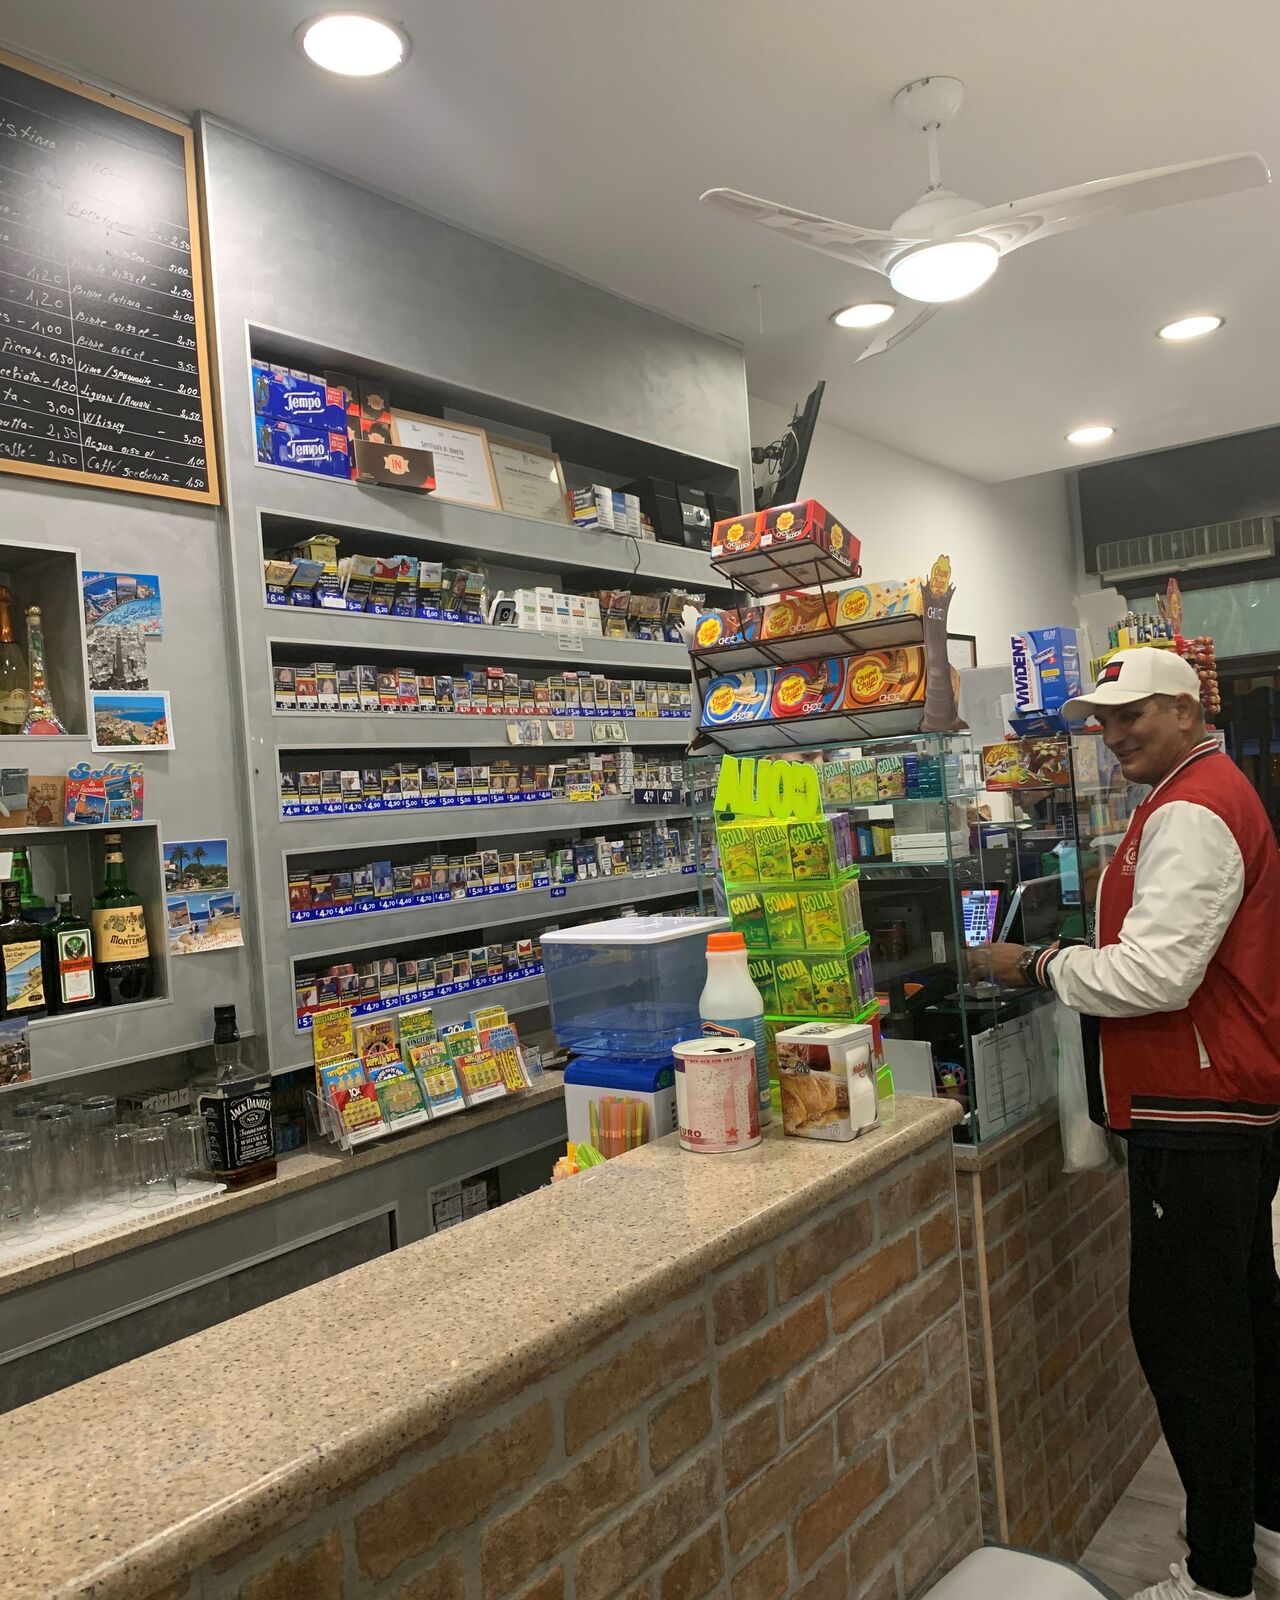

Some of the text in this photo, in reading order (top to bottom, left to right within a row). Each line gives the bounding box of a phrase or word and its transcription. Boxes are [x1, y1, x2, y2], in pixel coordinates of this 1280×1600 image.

[25, 289, 64, 308] 1,20
[170, 285, 192, 299] 2,50
[31, 321, 63, 335] 1,00
[115, 323, 136, 335] 0,33
[49, 352, 74, 365] 0,50
[111, 347, 132, 356] 0,66
[51, 377, 76, 392] 1,20
[46, 400, 75, 416] 3,00
[283, 391, 323, 413] Tempo
[46, 423, 78, 439] 2,50
[183, 434, 203, 445] 3,50
[287, 438, 326, 460] Tempo
[46, 450, 78, 465] 2,50
[187, 456, 205, 468] 1,00
[391, 458, 402, 471] IN
[185, 477, 205, 489] 1,50
[856, 667, 877, 684] Chupa
[856, 674, 879, 692] Chups
[67, 762, 144, 780] Saluti
[229, 1101, 248, 1121] JACK
[240, 1133, 269, 1146] WHISKEY
